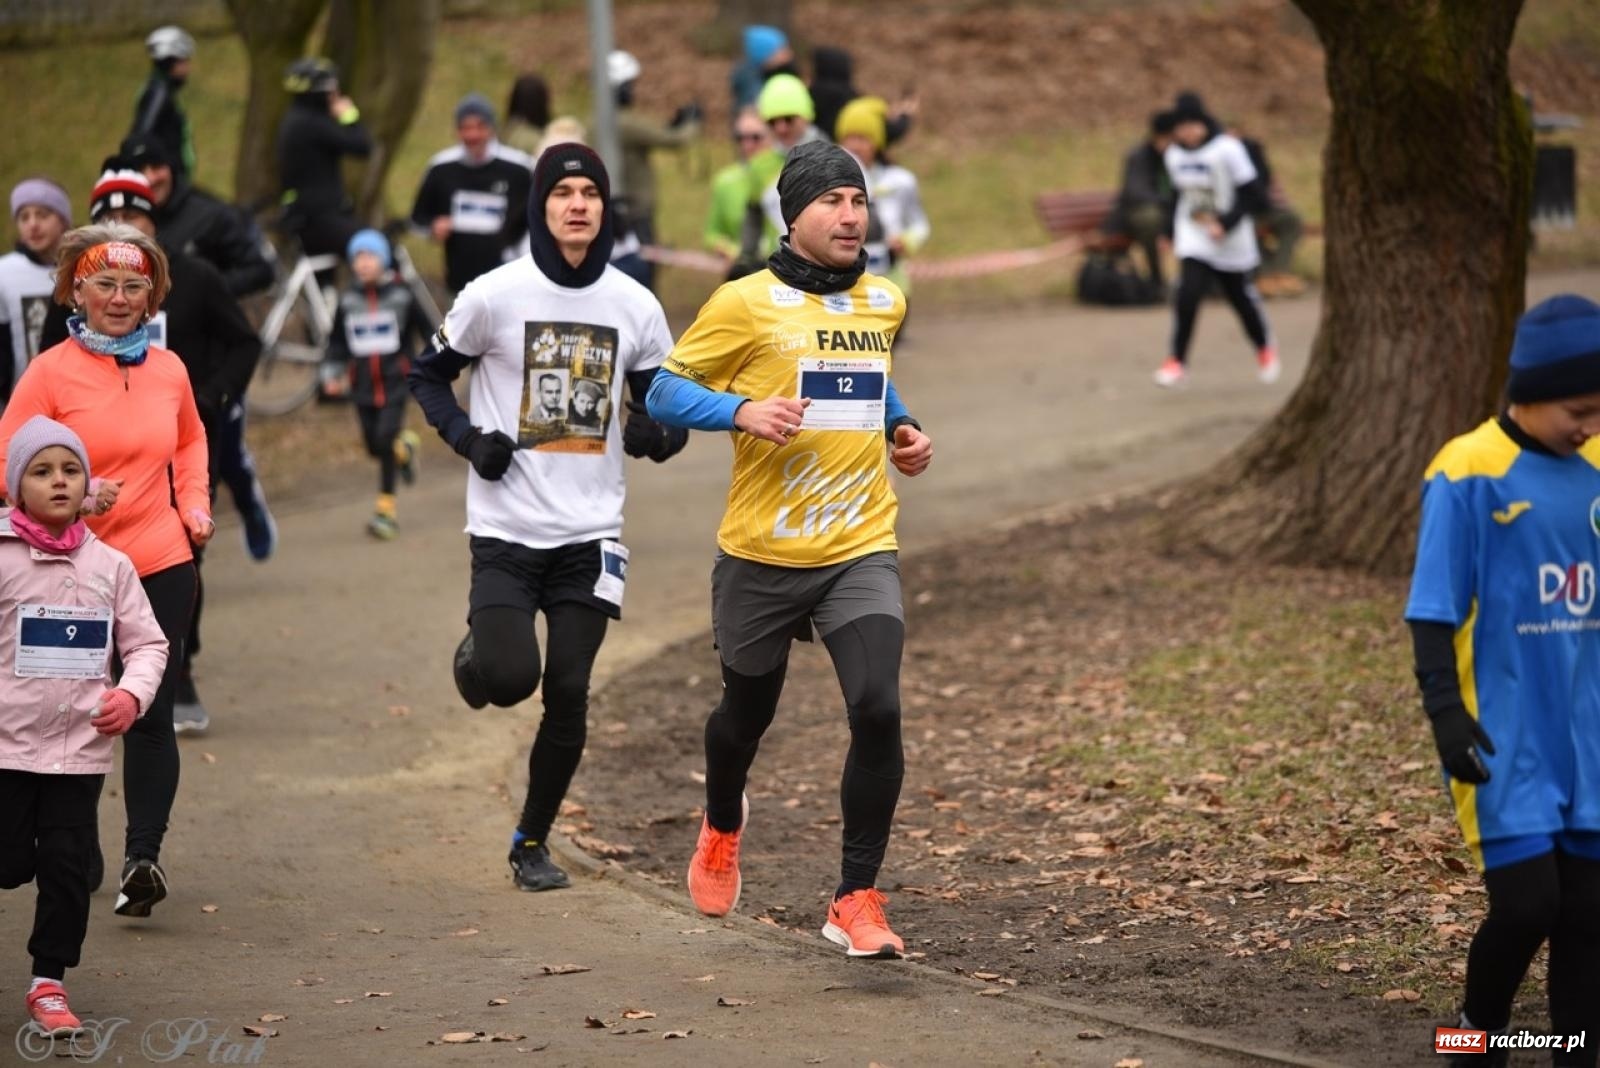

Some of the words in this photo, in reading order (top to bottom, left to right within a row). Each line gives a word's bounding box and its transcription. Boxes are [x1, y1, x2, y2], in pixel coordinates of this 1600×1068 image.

[816, 330, 891, 352] FAMILY
[836, 377, 854, 393] 12
[66, 625, 77, 641] 9
